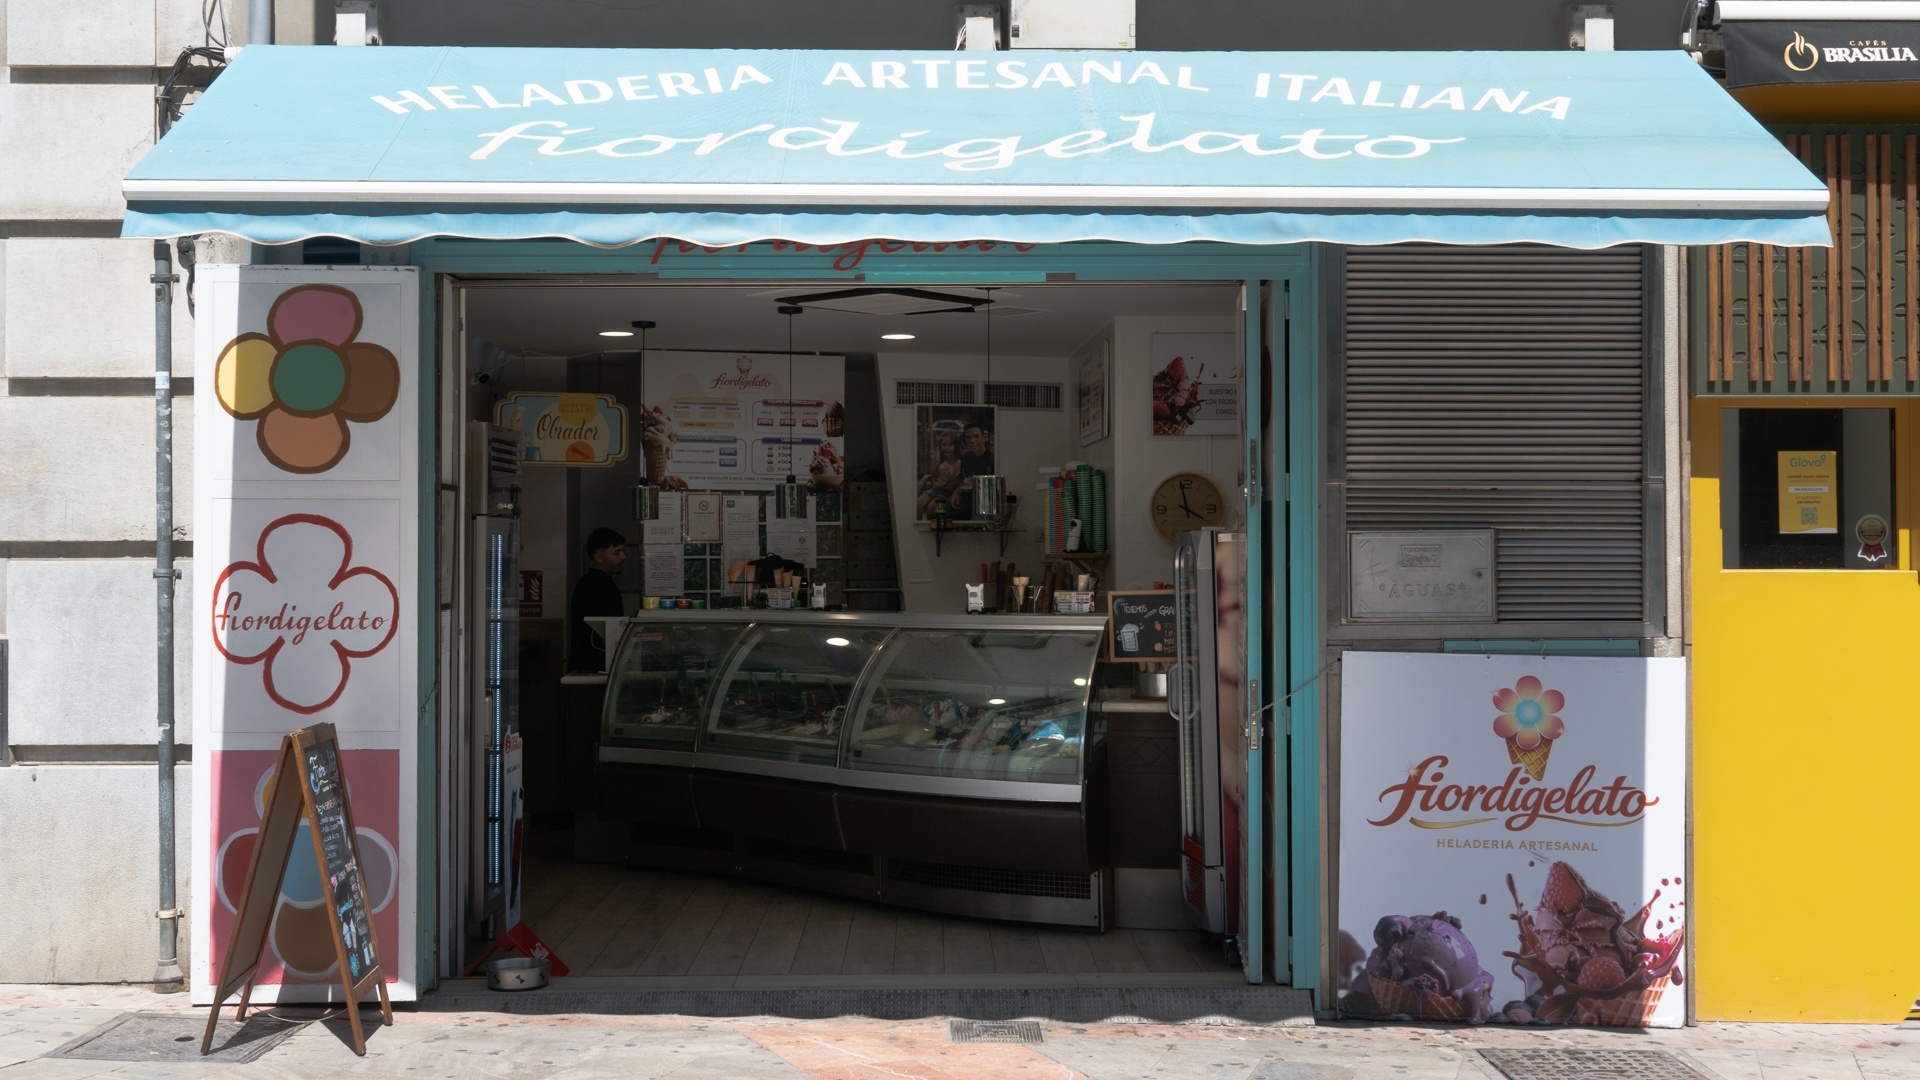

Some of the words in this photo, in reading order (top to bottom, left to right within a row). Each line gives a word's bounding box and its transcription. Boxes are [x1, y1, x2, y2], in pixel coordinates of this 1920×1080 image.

[1822, 47, 1918, 63] BRASILIA
[370, 64, 774, 115] HELADERIA
[822, 59, 1210, 92] ARTESANAL
[1255, 72, 1572, 121] ITALIANA
[469, 111, 1468, 172] fiordigelato
[710, 372, 774, 390] fiordigelato
[560, 403, 595, 413] NUESTRO
[536, 412, 600, 441] Obrador
[1789, 457, 1822, 467] Glovo
[1179, 479, 1193, 489] 12
[1156, 504, 1167, 514] 9
[1206, 504, 1217, 514] 3
[1388, 583, 1456, 598] AGUAS
[215, 591, 392, 645] fiordigelato
[1366, 755, 1660, 831] fiordigelato
[1437, 838, 1514, 850] HELADERIA
[1518, 840, 1598, 852] ARTESANAL
